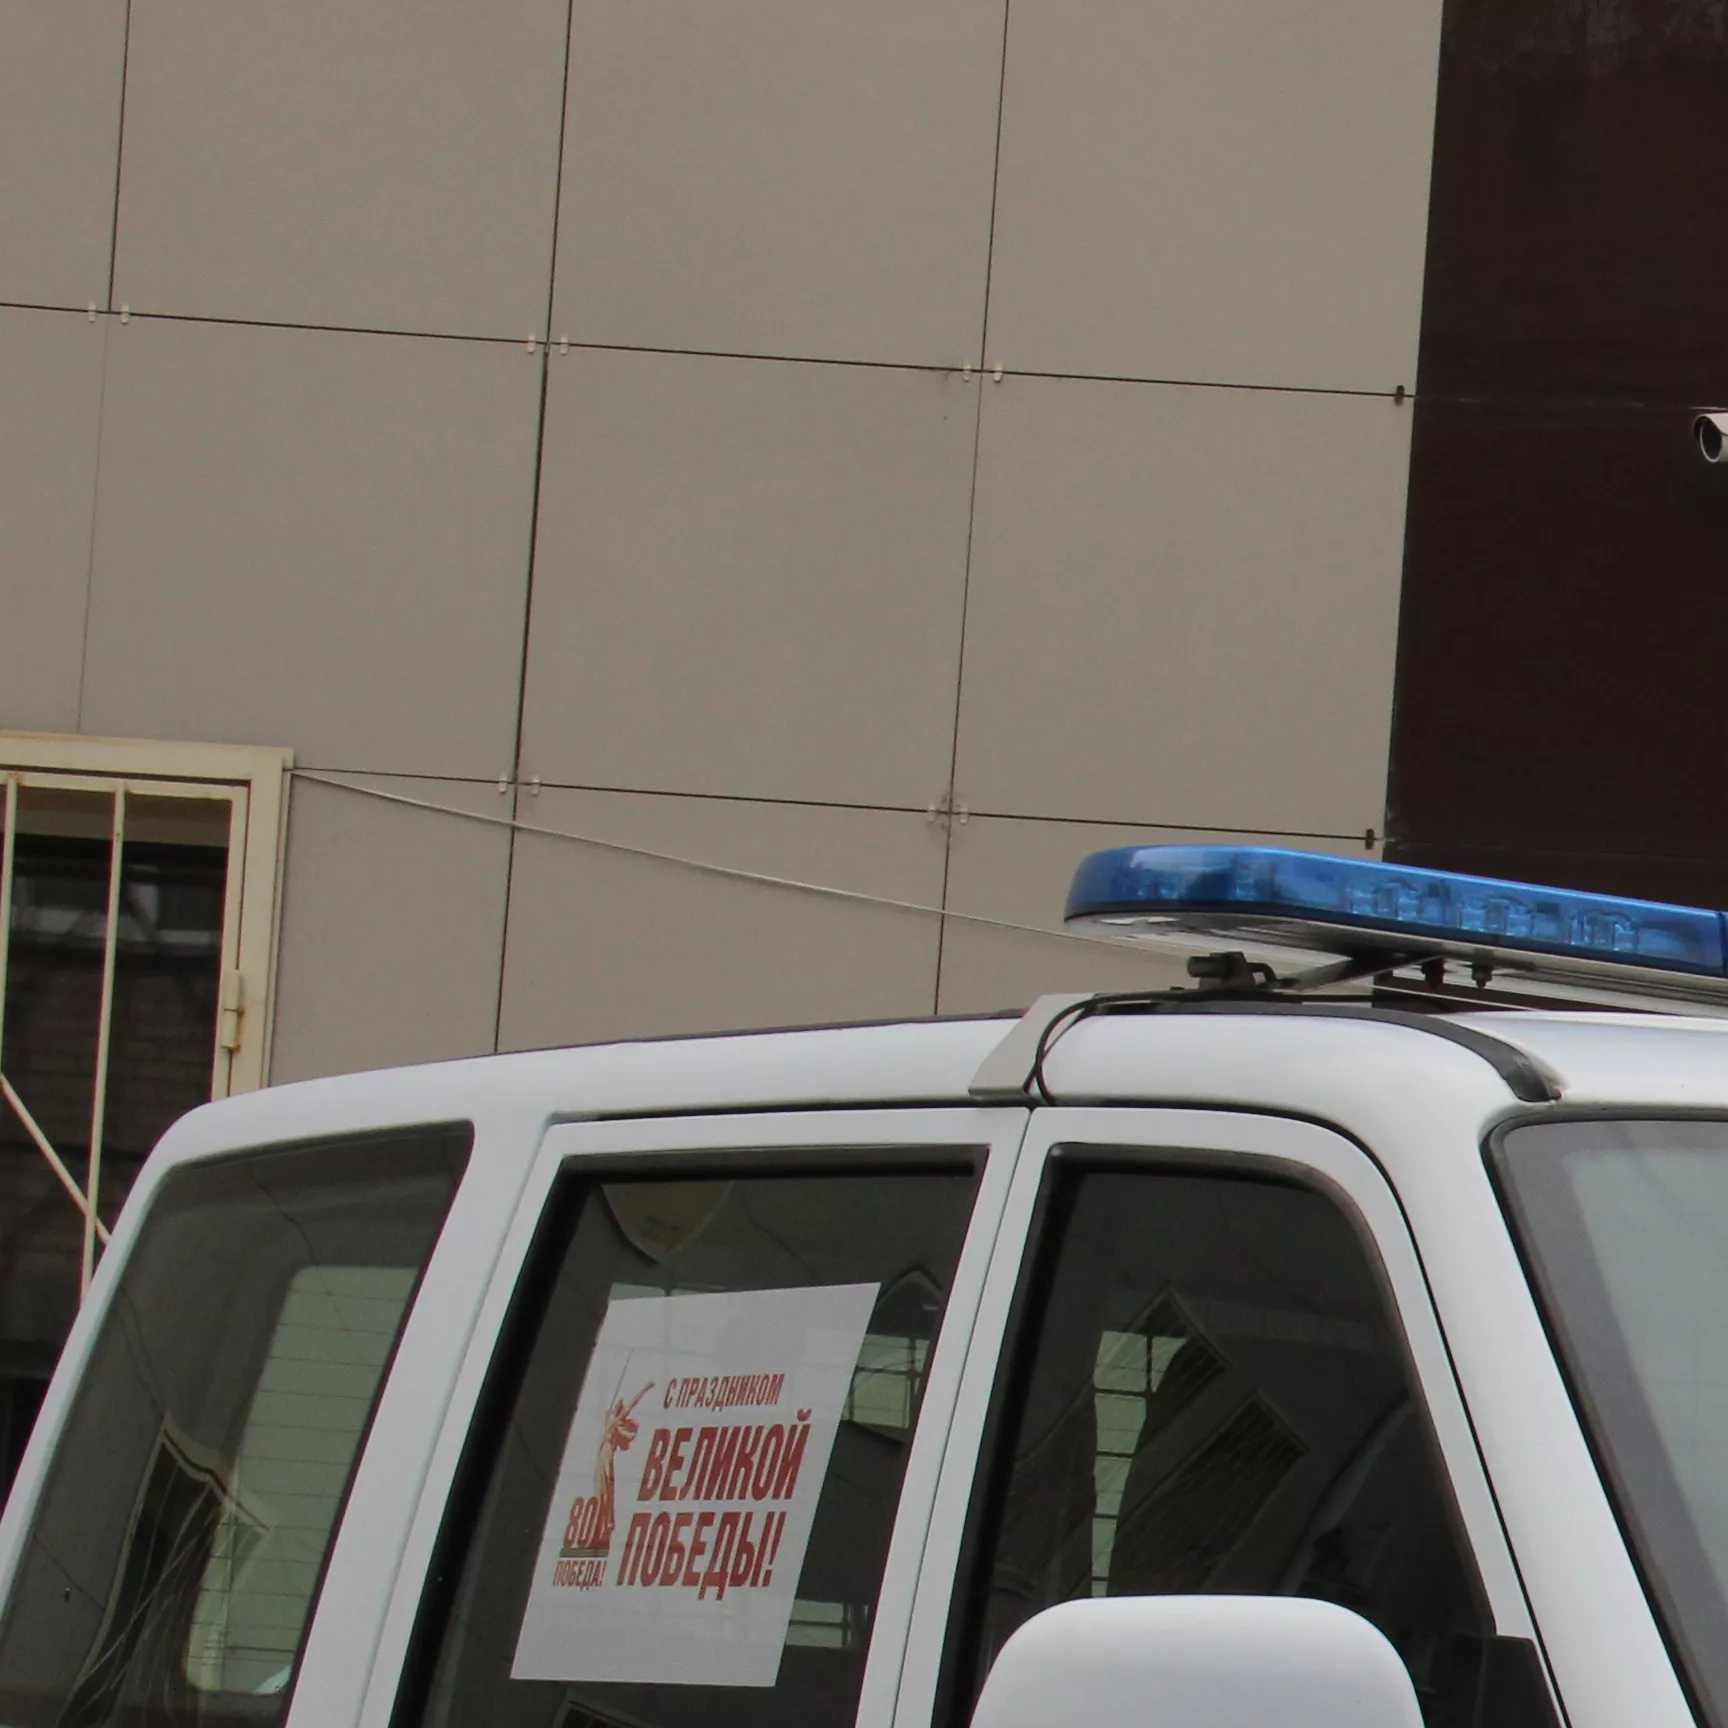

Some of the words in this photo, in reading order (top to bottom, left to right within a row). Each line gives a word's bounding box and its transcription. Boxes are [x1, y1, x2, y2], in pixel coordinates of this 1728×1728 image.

[663, 1378, 677, 1409] С
[676, 1373, 785, 1412] ПРАЗДНИКОМ
[637, 1408, 812, 1501] ВЕЛИКОЙ
[553, 1560, 607, 1592] ПОБЕДА!
[615, 1511, 787, 1600] ПОБЕДЫ!
